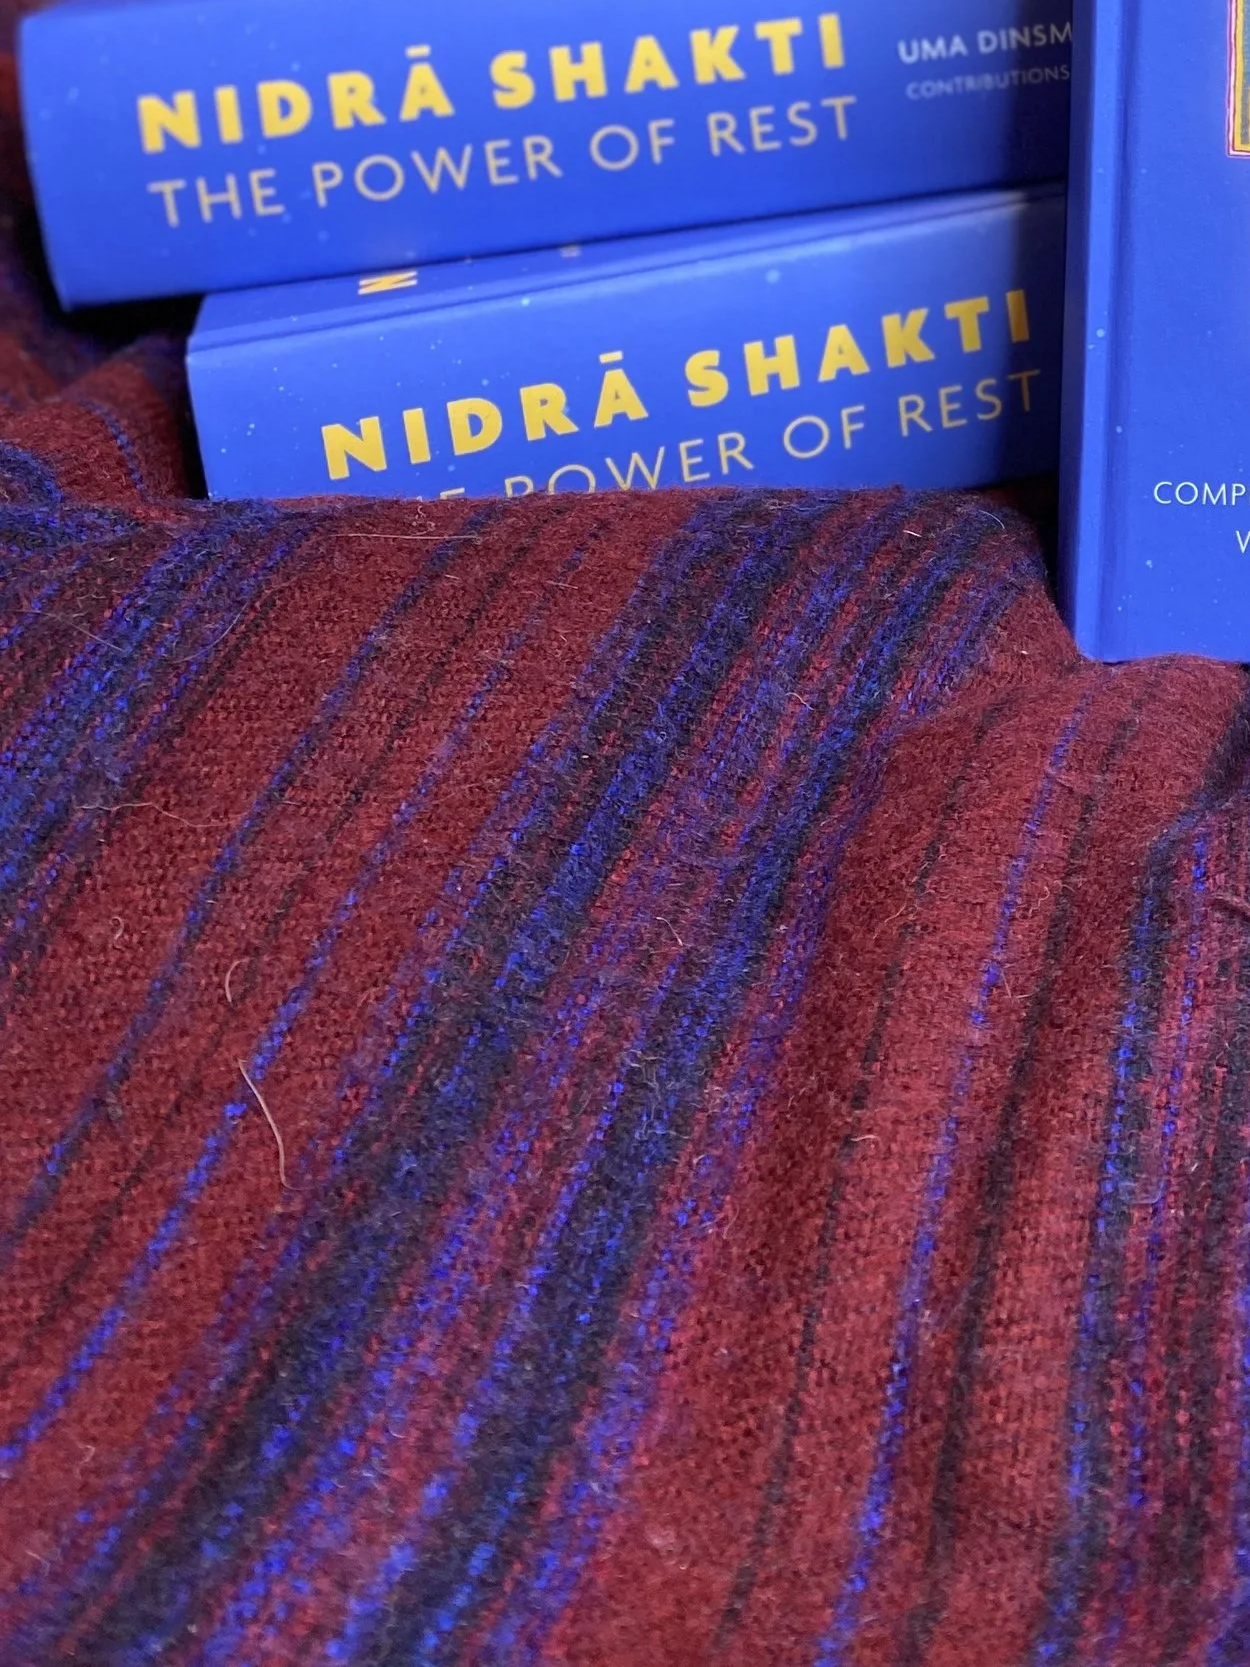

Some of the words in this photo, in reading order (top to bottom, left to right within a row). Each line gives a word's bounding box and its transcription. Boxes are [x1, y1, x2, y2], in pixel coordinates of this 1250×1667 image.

[137, 44, 455, 153] NIDRĀ
[489, 13, 844, 109] SHAKTI
[898, 35, 968, 64] UMA
[906, 64, 1070, 100] CONTRIBUTIONS
[147, 169, 284, 227] THE
[312, 137, 562, 207] POWER
[590, 119, 675, 170] OF
[708, 96, 857, 156] REST
[320, 350, 649, 480] NIDRĀ
[684, 289, 1030, 407] SHAKTI
[783, 405, 865, 459] OF
[898, 368, 1041, 436] REST
